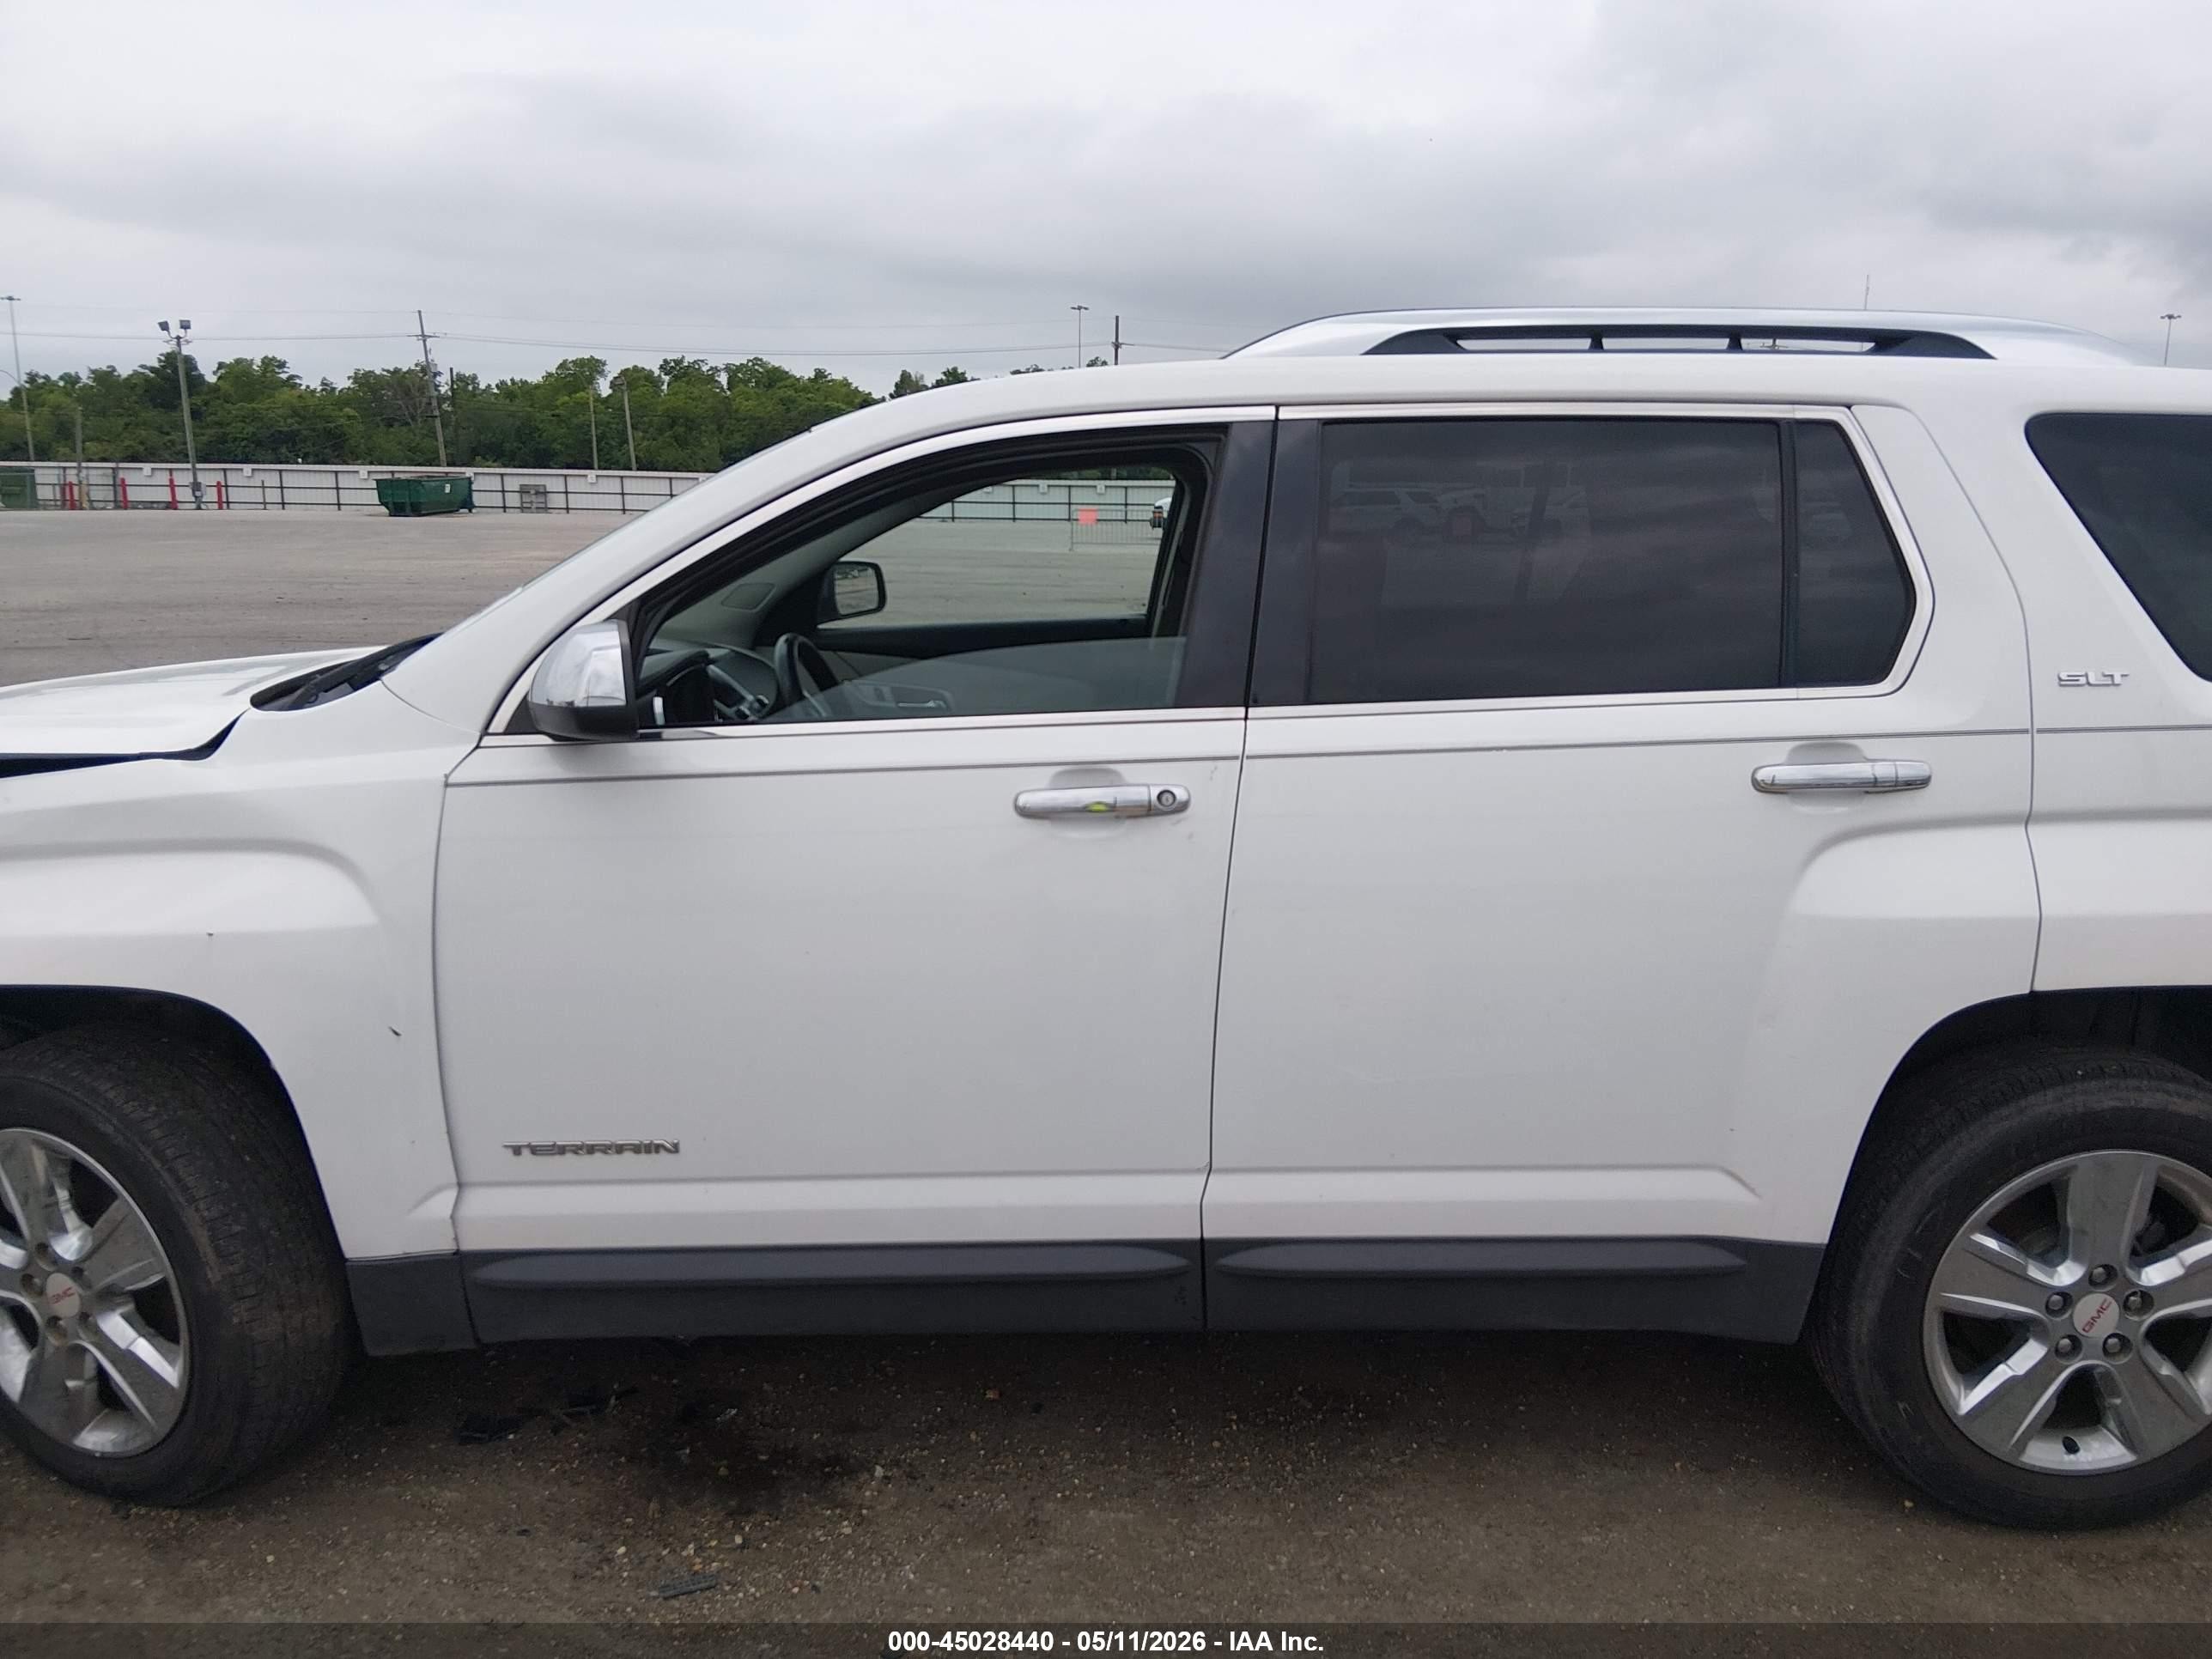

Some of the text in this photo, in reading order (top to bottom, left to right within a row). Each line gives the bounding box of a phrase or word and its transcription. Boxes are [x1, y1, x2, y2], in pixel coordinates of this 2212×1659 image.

[2057, 672, 2129, 687] SLT
[503, 1139, 680, 1156] TERRAIN
[2081, 1297, 2112, 1334] GMC
